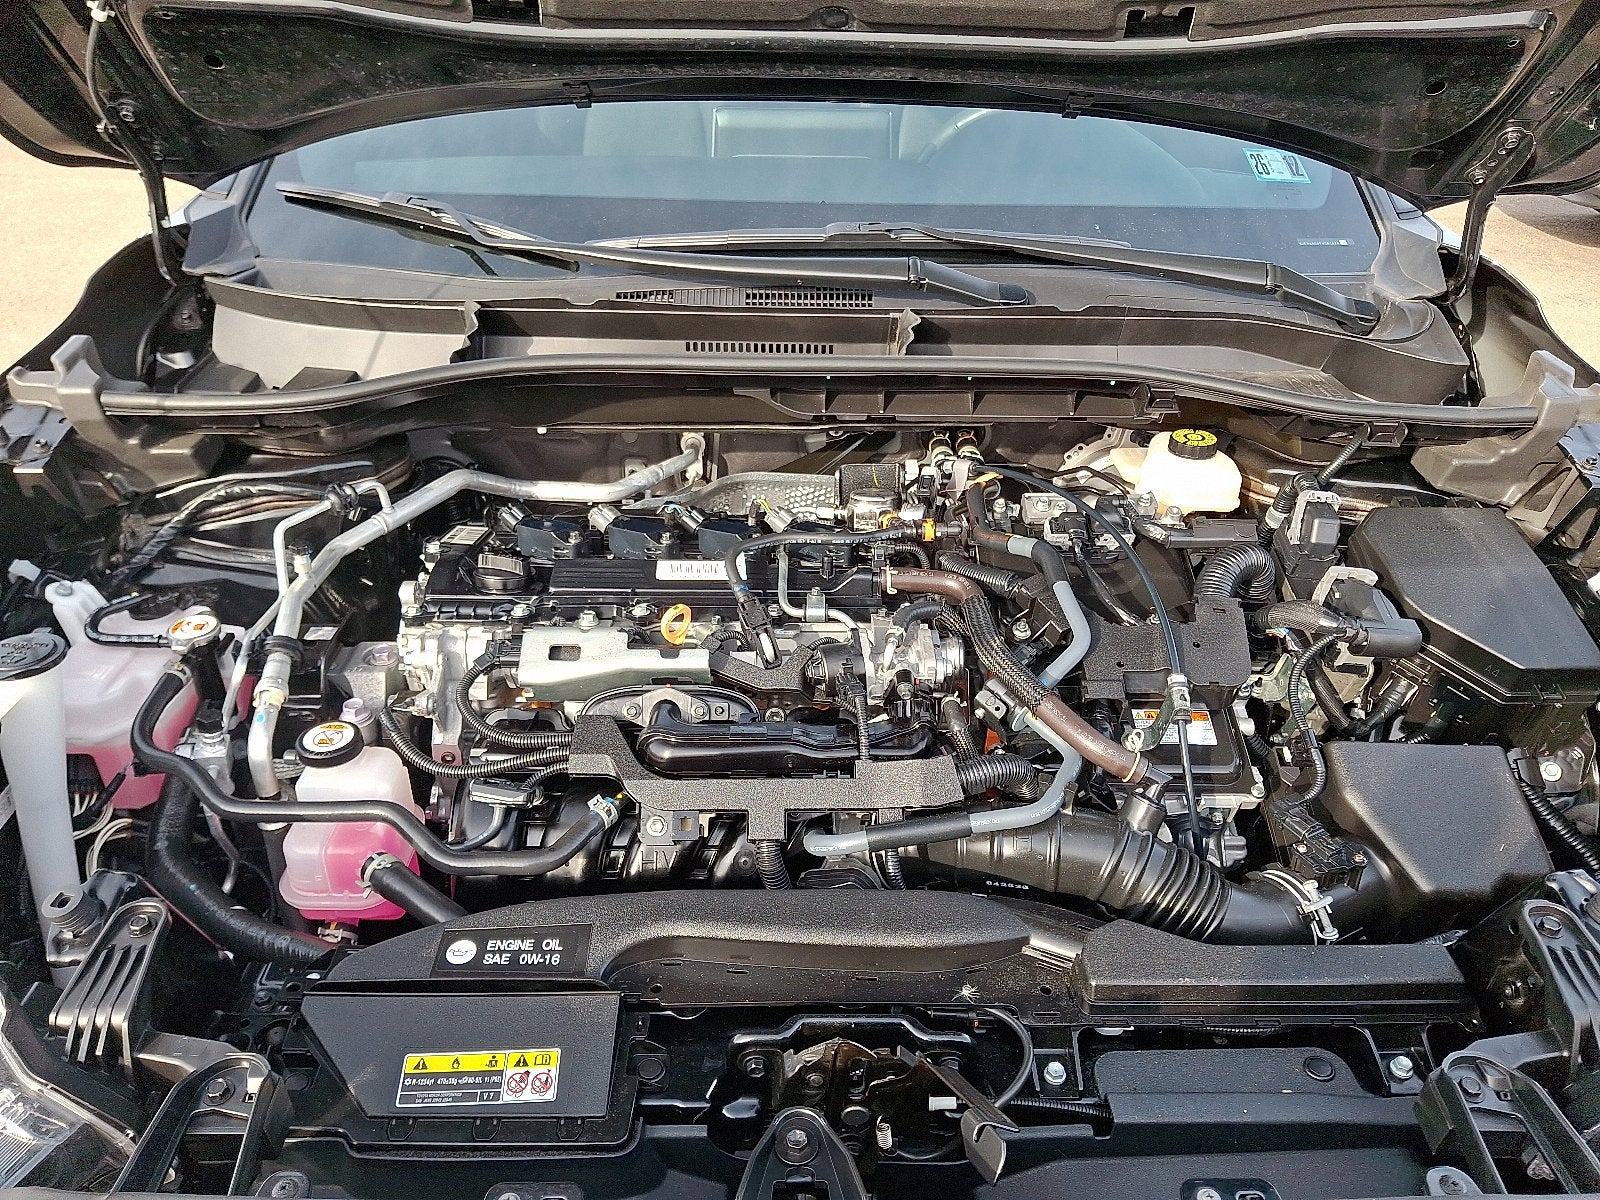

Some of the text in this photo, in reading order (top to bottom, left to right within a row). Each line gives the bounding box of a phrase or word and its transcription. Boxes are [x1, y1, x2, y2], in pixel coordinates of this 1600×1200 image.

[1249, 153, 1270, 175] 26
[486, 939, 563, 951] ENGINE OIL
[482, 953, 561, 966] SAE 0W-16
